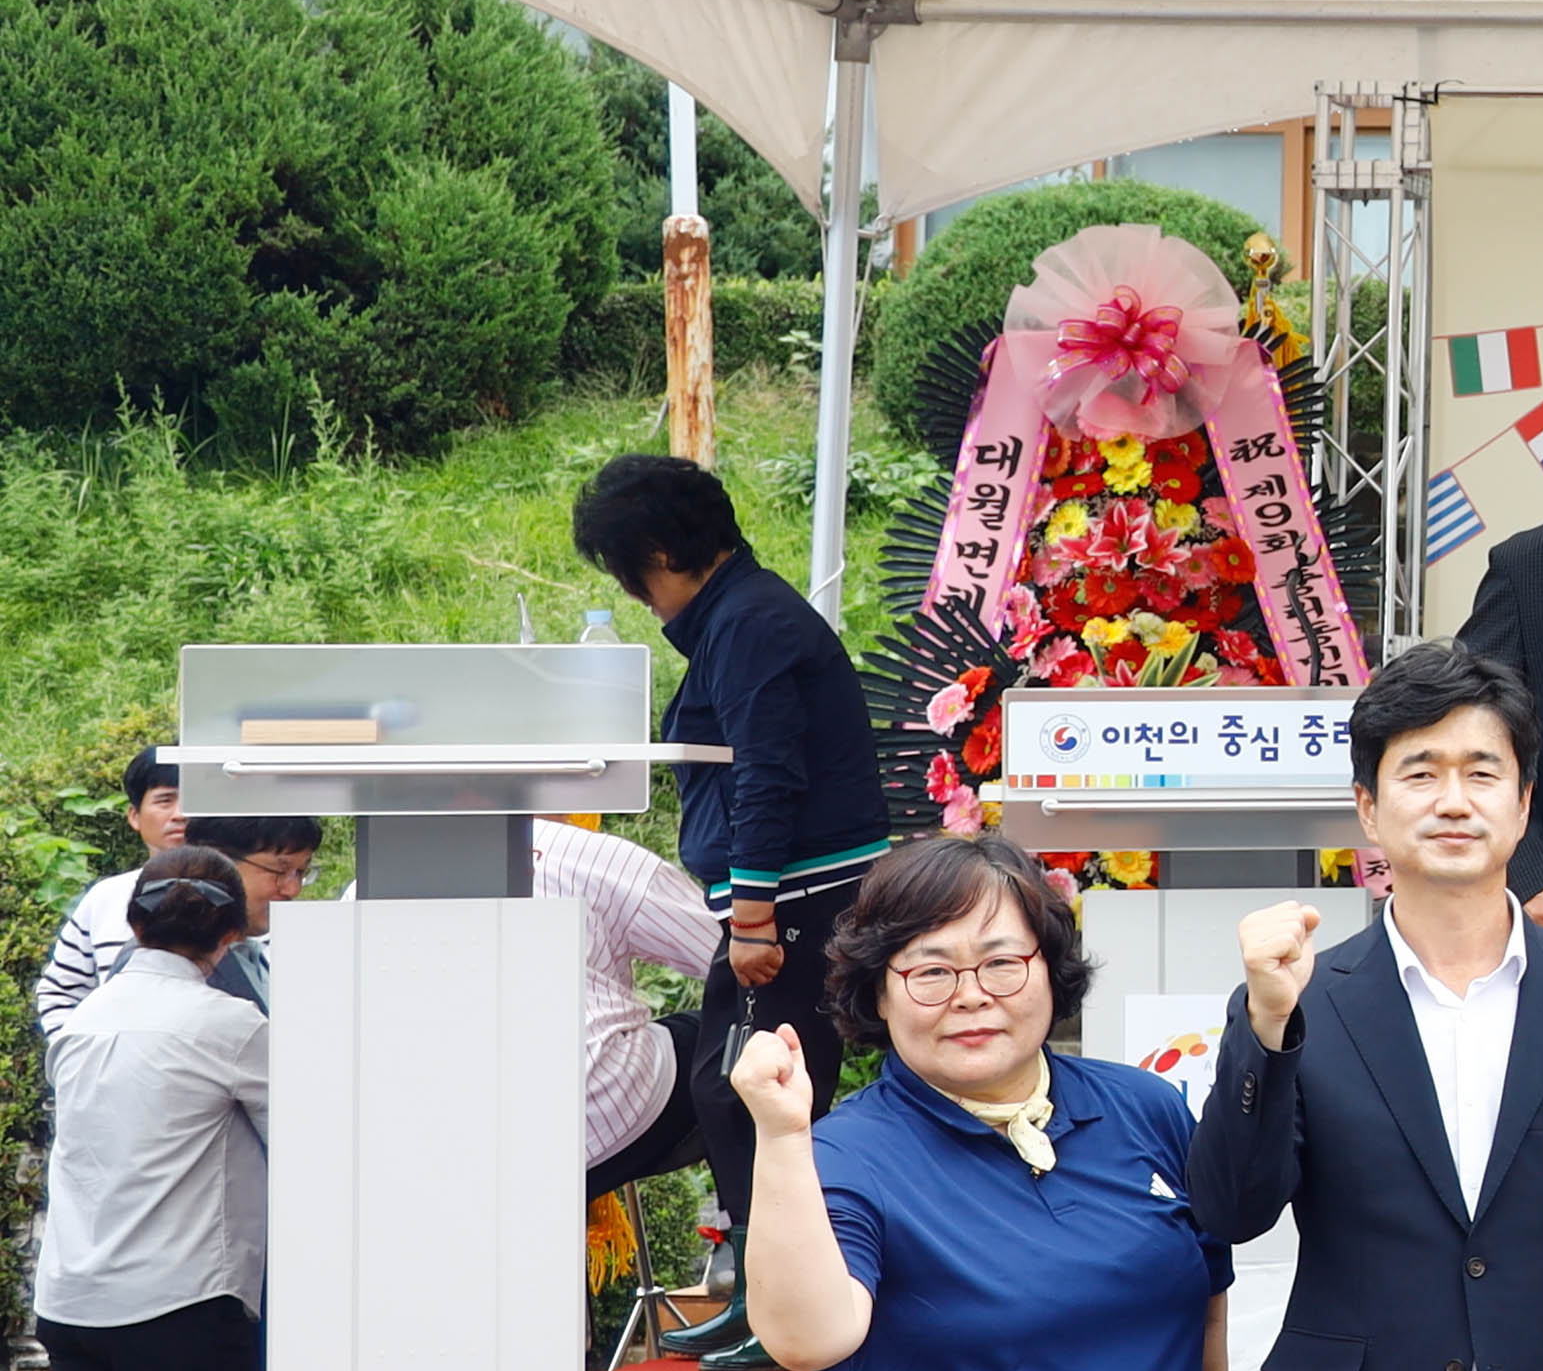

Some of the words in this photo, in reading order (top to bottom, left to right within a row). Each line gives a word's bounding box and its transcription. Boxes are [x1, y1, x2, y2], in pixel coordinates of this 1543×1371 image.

[1229, 432, 1286, 463] 祝
[1102, 721, 1198, 763] 이천의
[1217, 715, 1279, 763] 중심
